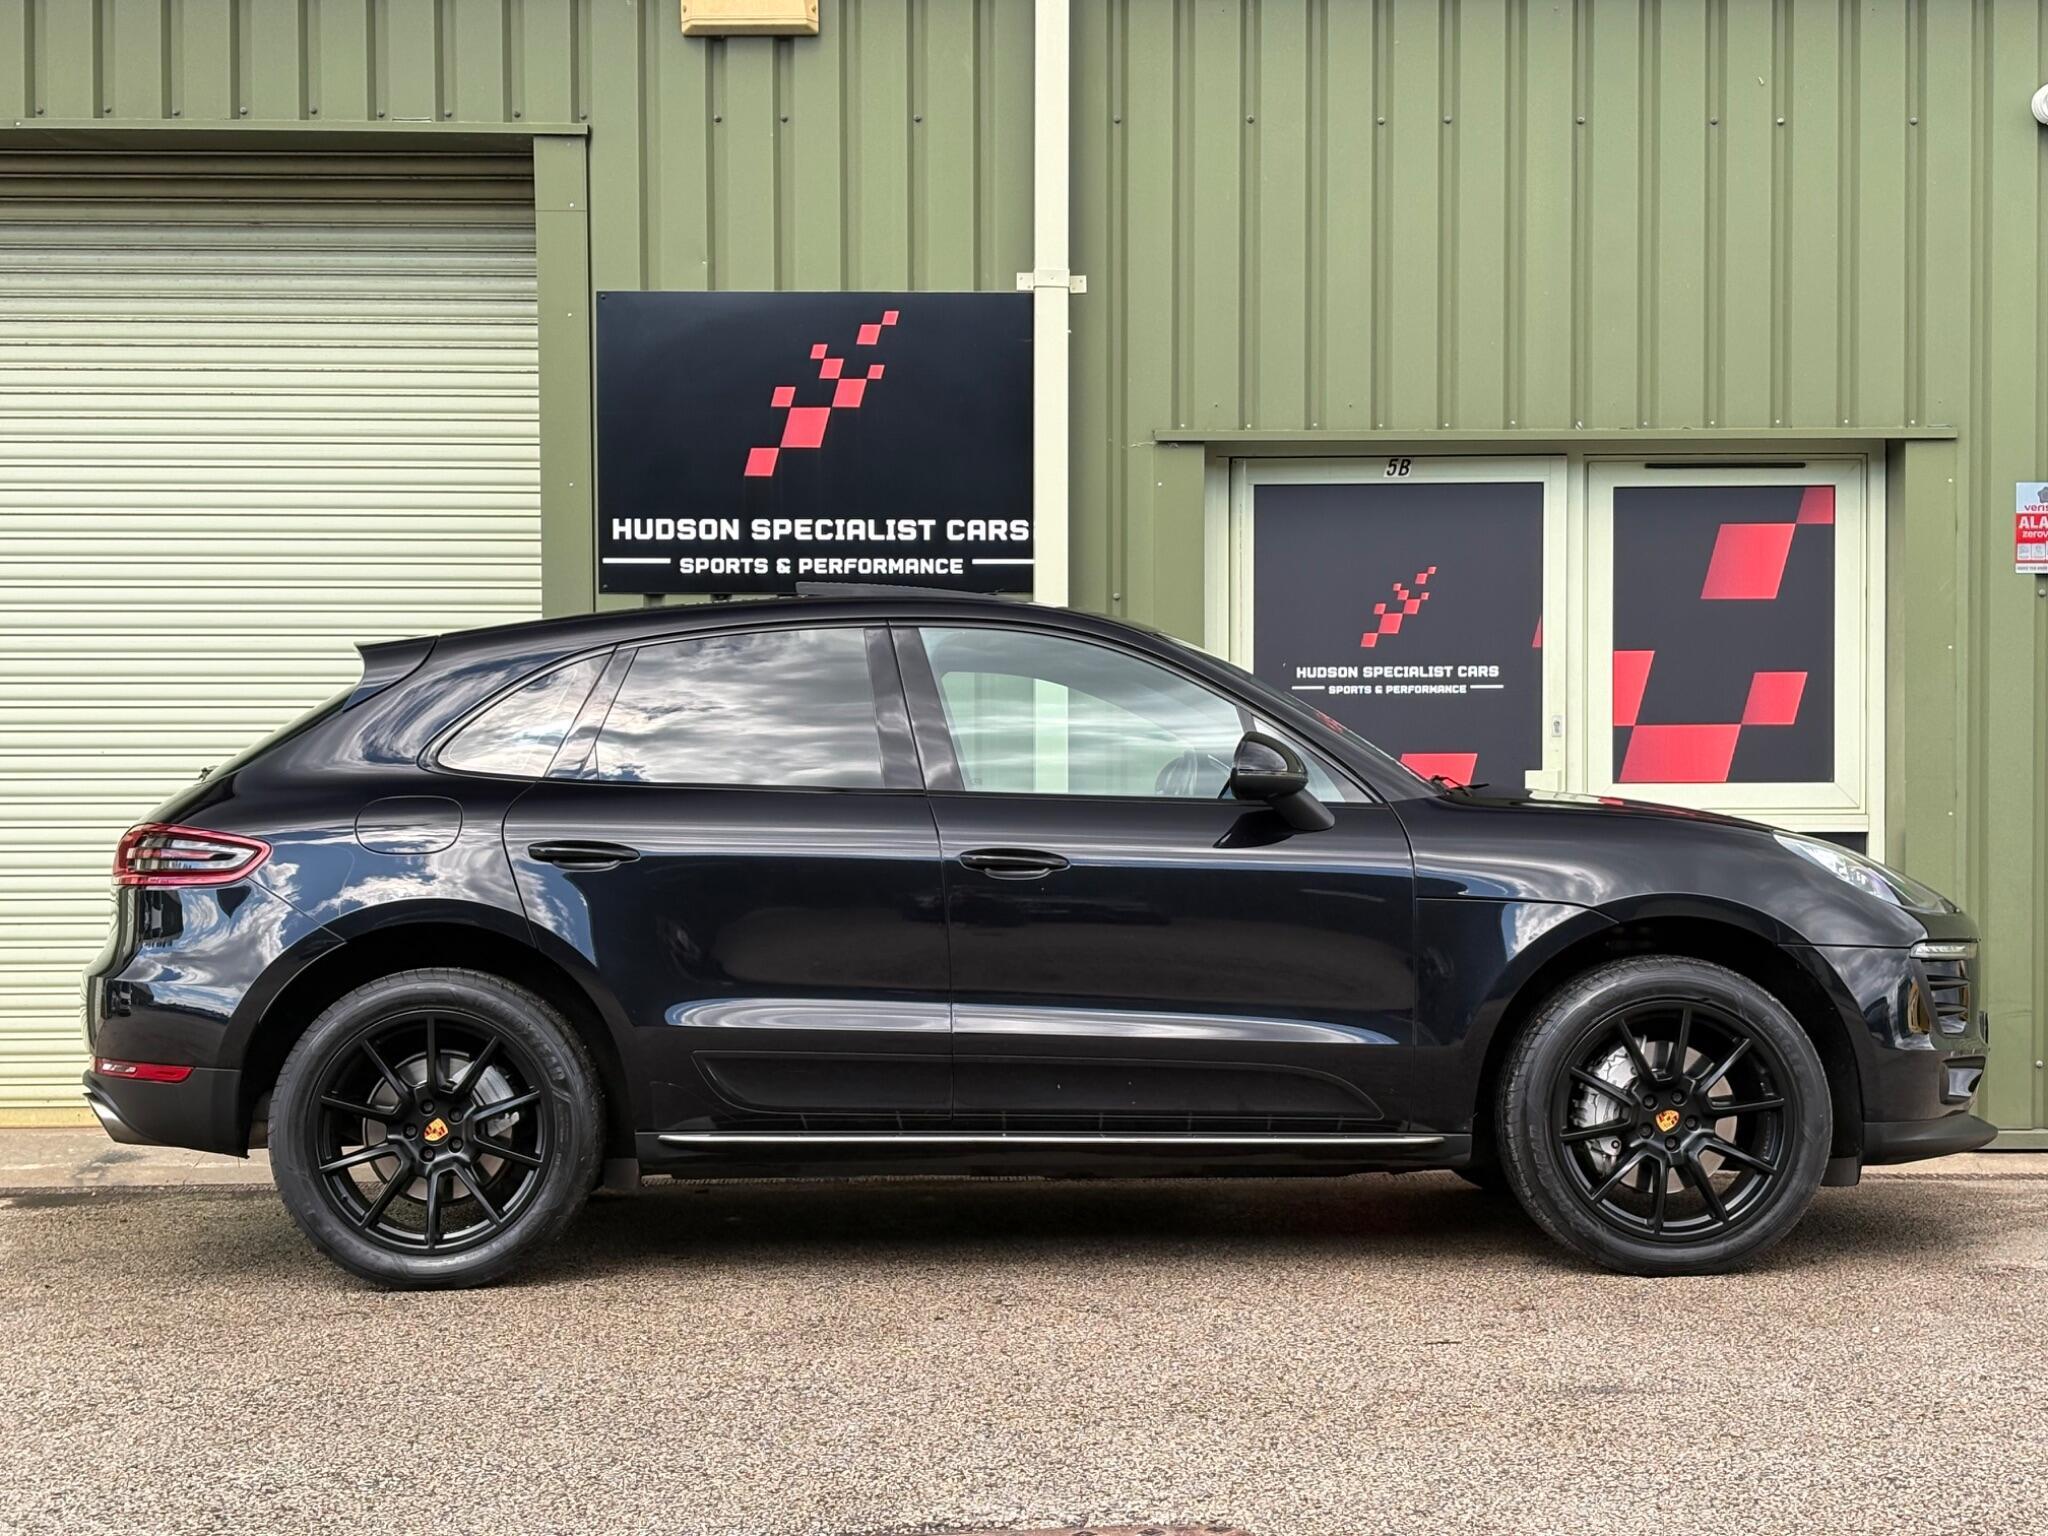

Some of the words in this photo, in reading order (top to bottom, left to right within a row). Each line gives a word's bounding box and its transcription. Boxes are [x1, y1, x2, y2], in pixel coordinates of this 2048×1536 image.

[1386, 458, 1411, 476] 5B
[612, 518, 740, 541] HUDSON
[751, 519, 937, 541] SPECIALIST
[946, 519, 1030, 541] CARS
[2018, 515, 2048, 529] ALA
[679, 557, 769, 575] SPORTS
[776, 558, 792, 574] &
[798, 557, 964, 575] PERFORMANCE
[1296, 666, 1358, 679] HUDSON
[1363, 665, 1453, 678] SPECIALIST
[1457, 665, 1500, 678] CARS
[1328, 685, 1373, 695] SPORTS
[1375, 685, 1382, 694] &
[1385, 684, 1467, 694] PERFORMANCE
